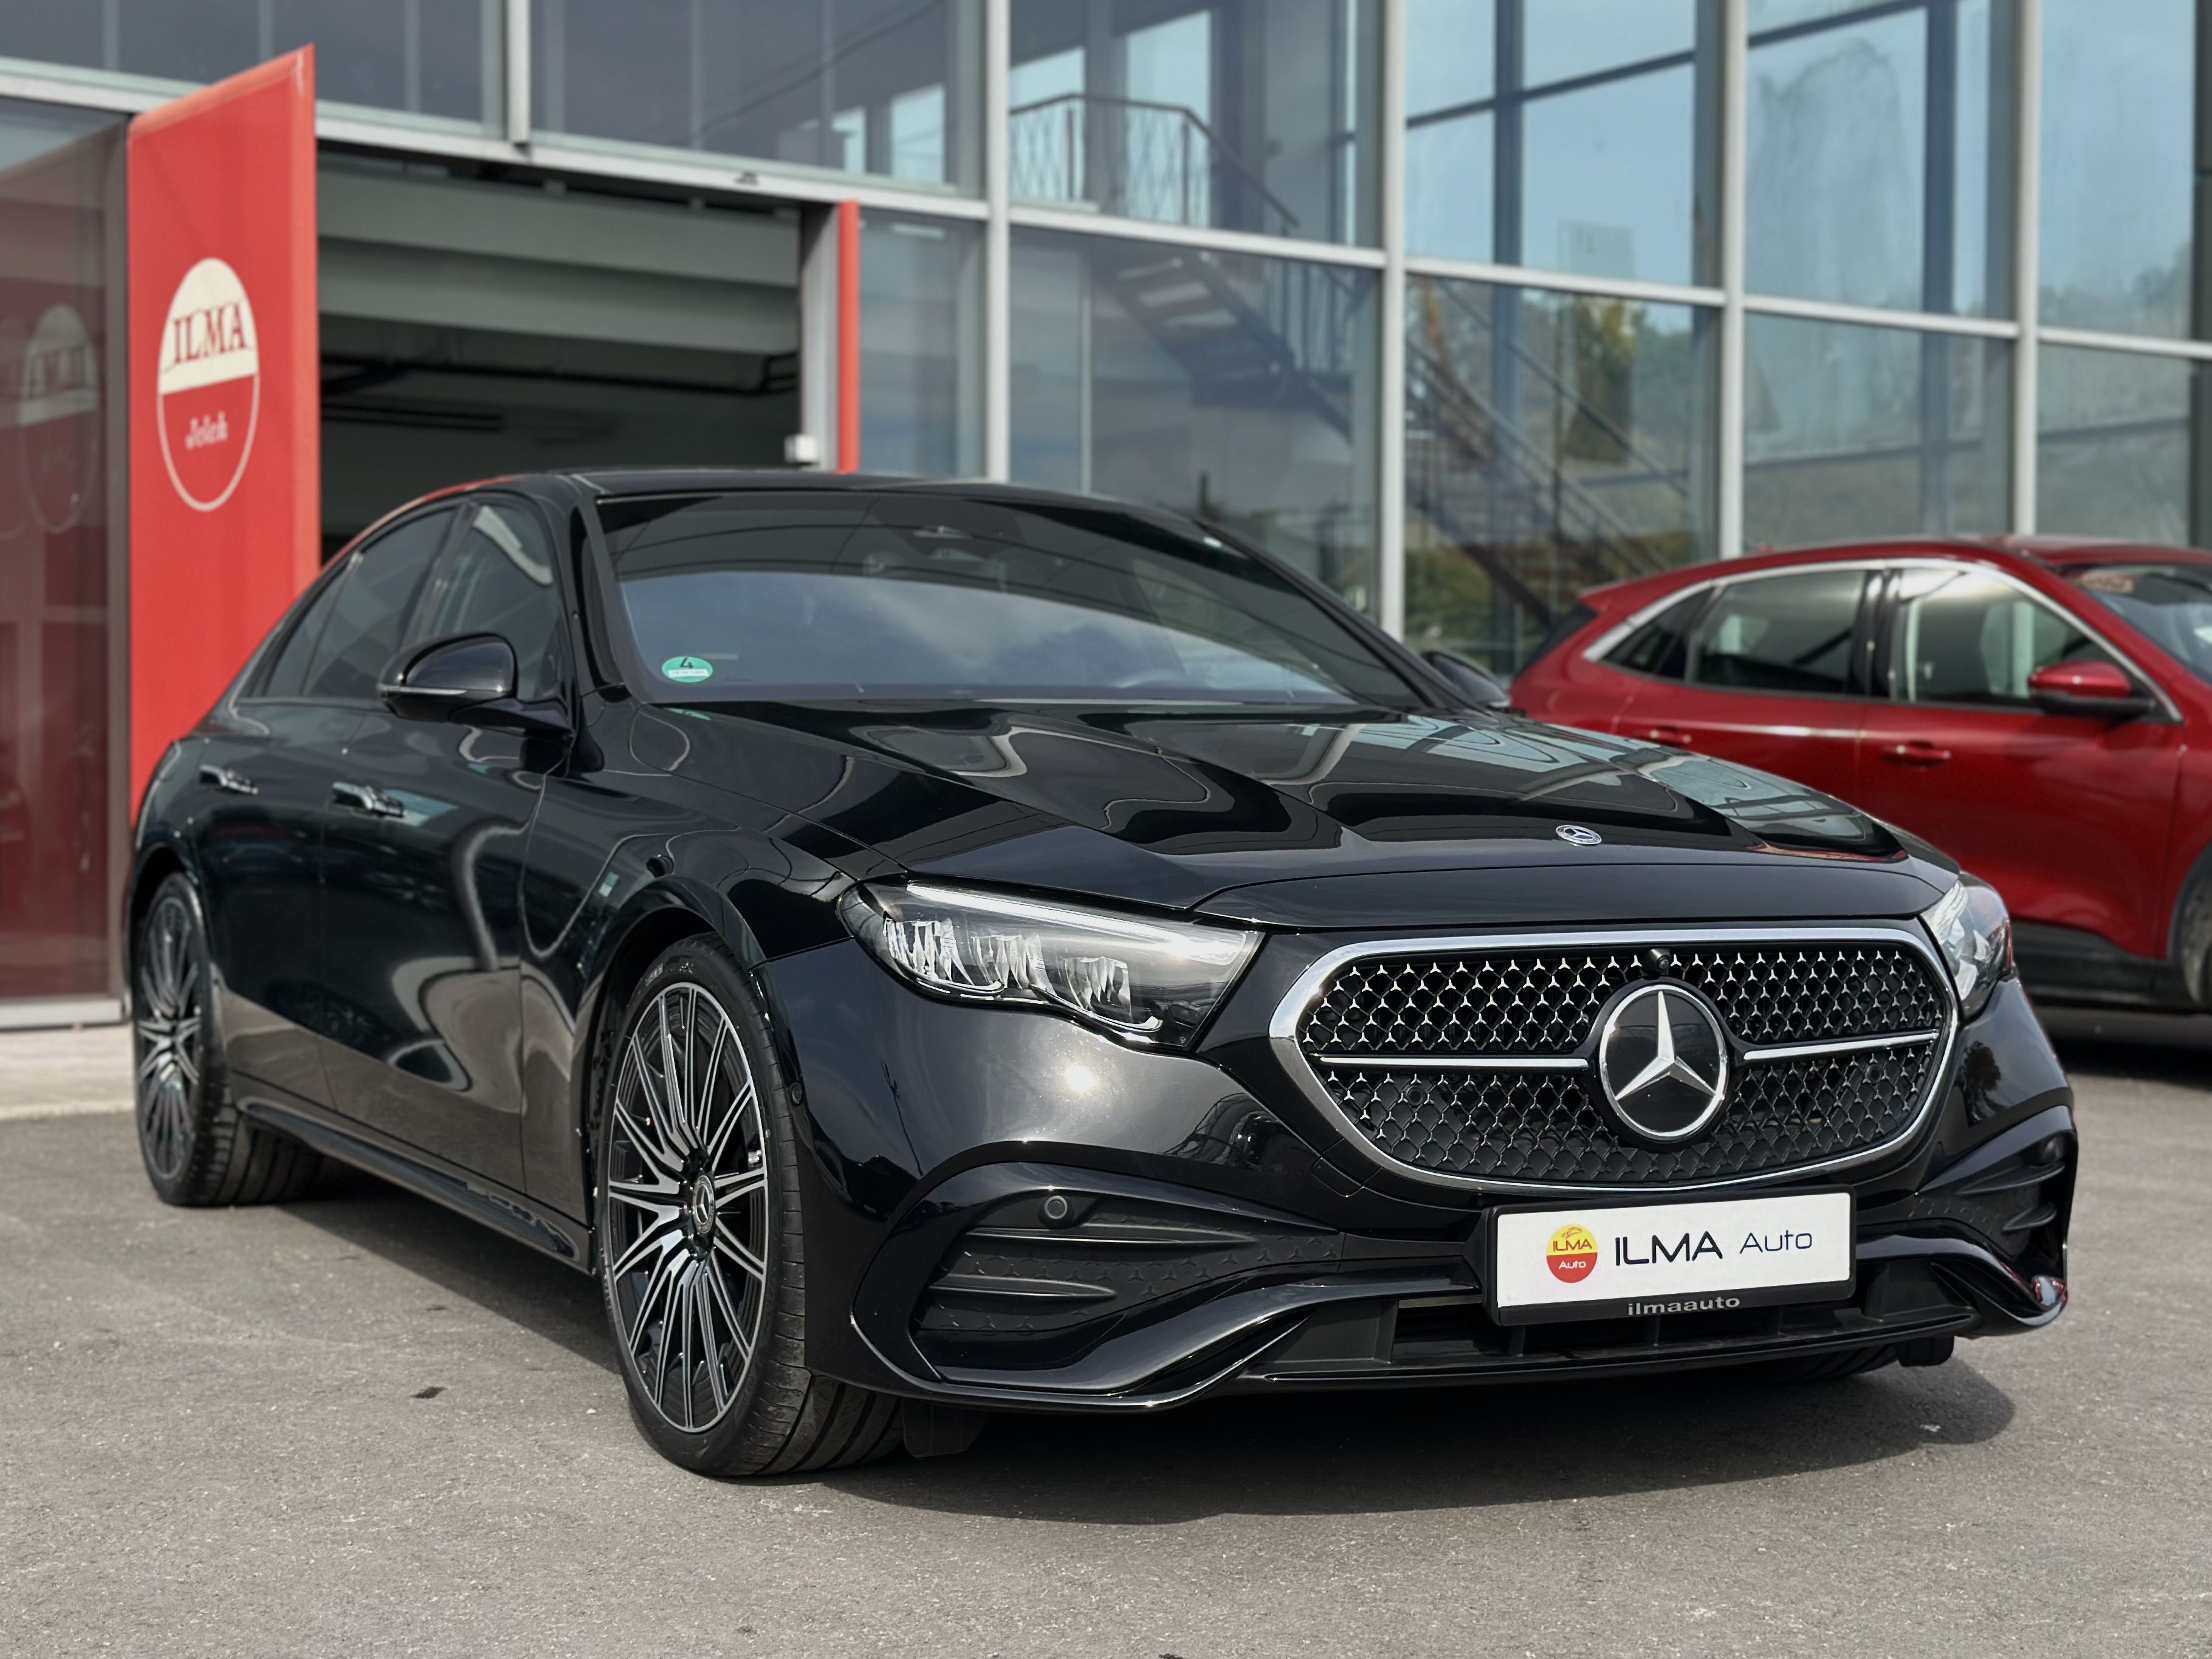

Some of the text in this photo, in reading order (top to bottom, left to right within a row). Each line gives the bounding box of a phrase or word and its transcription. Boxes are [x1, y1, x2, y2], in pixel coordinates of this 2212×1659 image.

[174, 302, 247, 365] ILMA
[679, 657, 694, 669] 4
[1553, 1238, 1593, 1252] ILMA
[1615, 1229, 1812, 1266] ILMA Auto
[1558, 1260, 1587, 1270] Auto
[1628, 1296, 1740, 1316] ilmaauto
